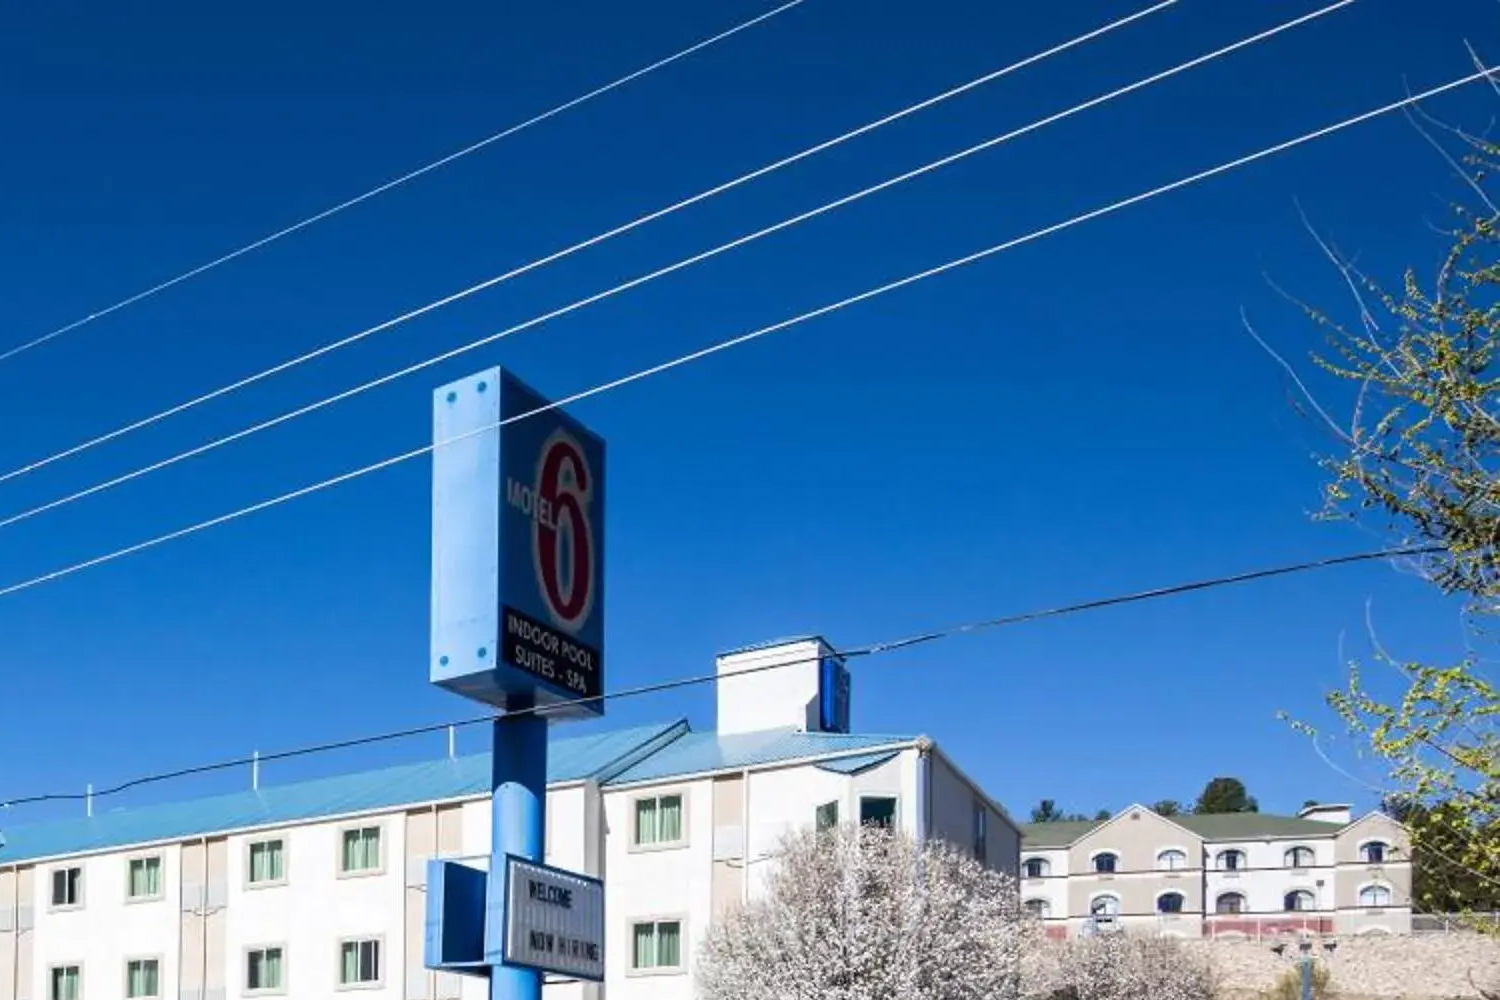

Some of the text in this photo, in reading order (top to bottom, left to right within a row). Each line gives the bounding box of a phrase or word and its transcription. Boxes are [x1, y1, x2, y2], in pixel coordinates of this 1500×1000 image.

[507, 434, 592, 627] MOTEL 6
[508, 614, 593, 671] INDOOR POOL
[515, 645, 555, 679] SUITES
[566, 669, 587, 694] SPA
[528, 879, 573, 910] WELCOME
[530, 930, 600, 962] NOW HIRING
